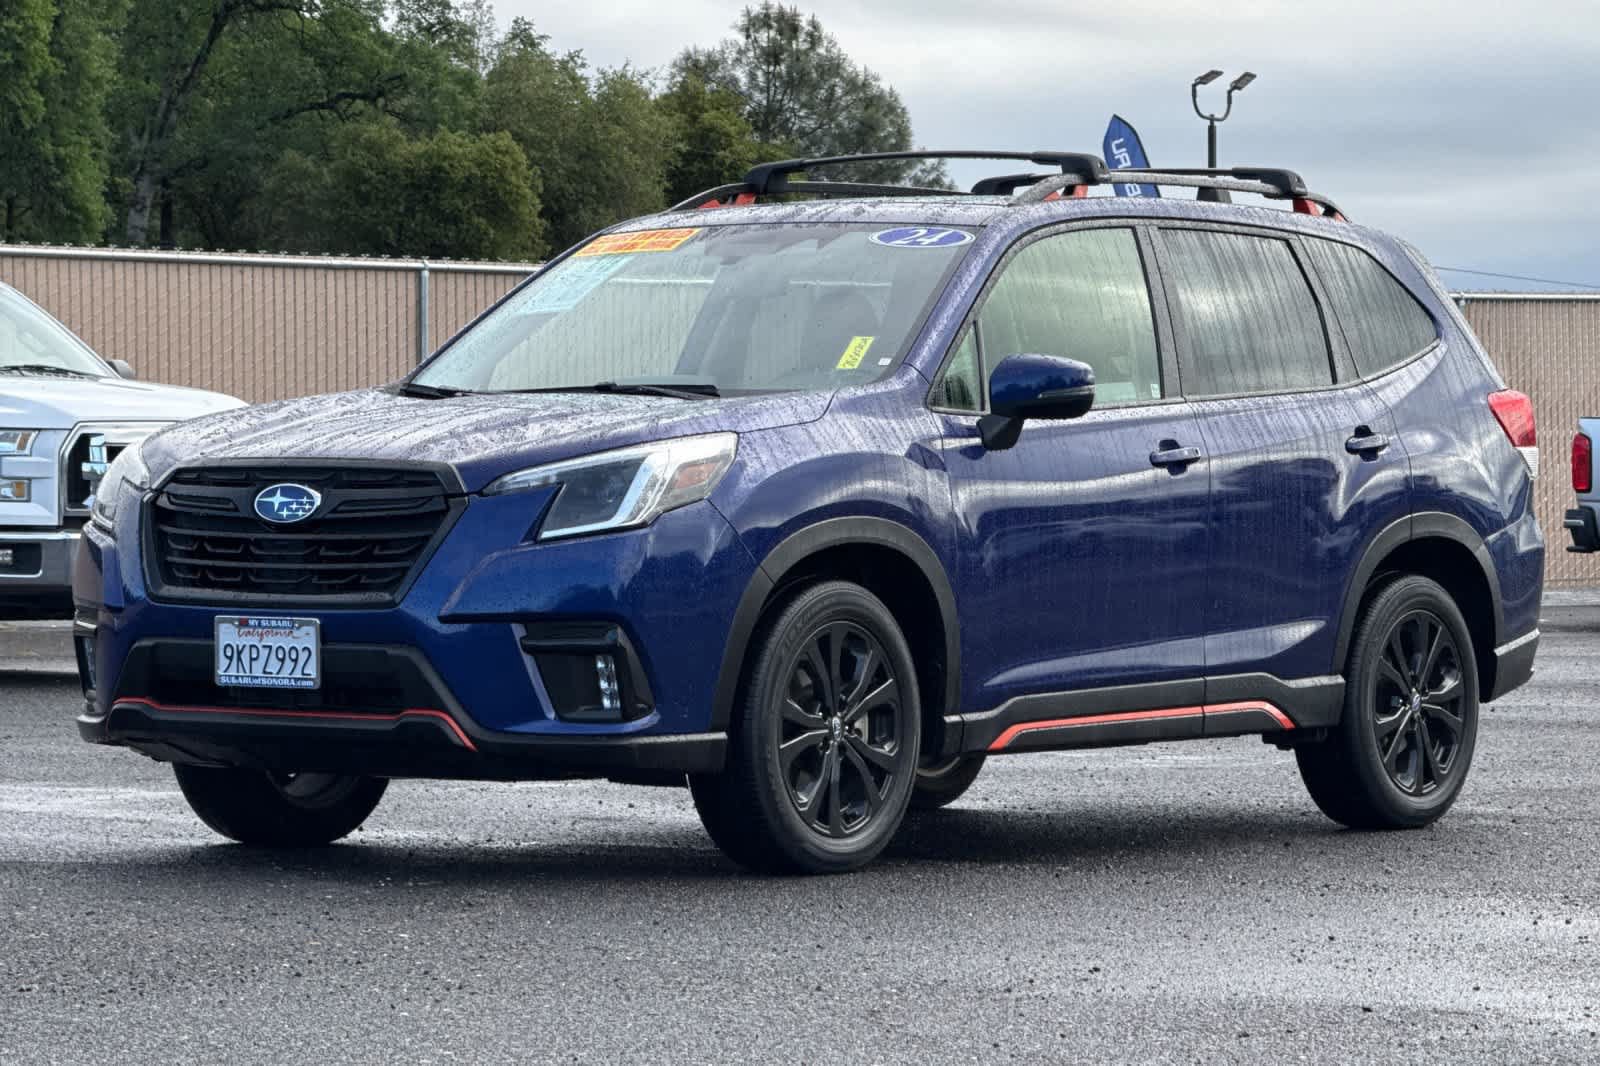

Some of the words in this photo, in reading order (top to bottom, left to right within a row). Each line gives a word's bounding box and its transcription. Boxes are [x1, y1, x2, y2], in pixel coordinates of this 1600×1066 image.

[890, 229, 954, 245] 24
[260, 619, 293, 628] SUBARU
[237, 628, 296, 641] California
[223, 643, 313, 676] 9KPZ992
